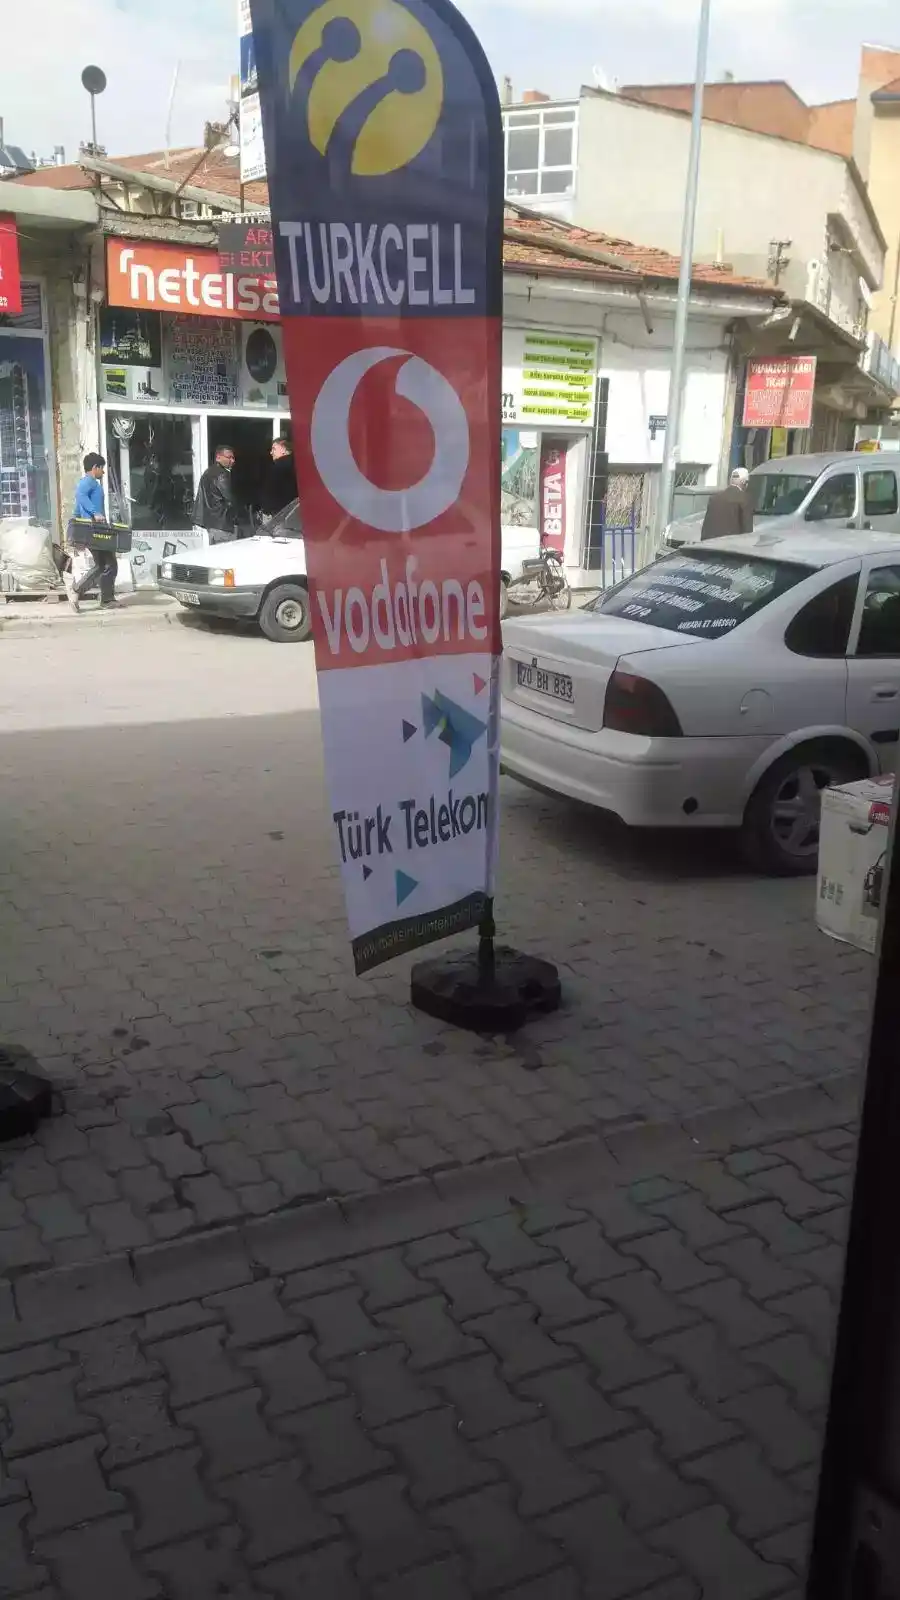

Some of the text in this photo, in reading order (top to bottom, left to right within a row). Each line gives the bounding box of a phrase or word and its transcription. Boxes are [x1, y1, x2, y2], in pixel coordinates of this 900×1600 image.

[279, 221, 475, 306] TURKCELL
[543, 472, 563, 536] BETA
[316, 555, 488, 654] vodafone
[521, 668, 573, 698] 70 BH 833
[333, 803, 393, 863] Türk
